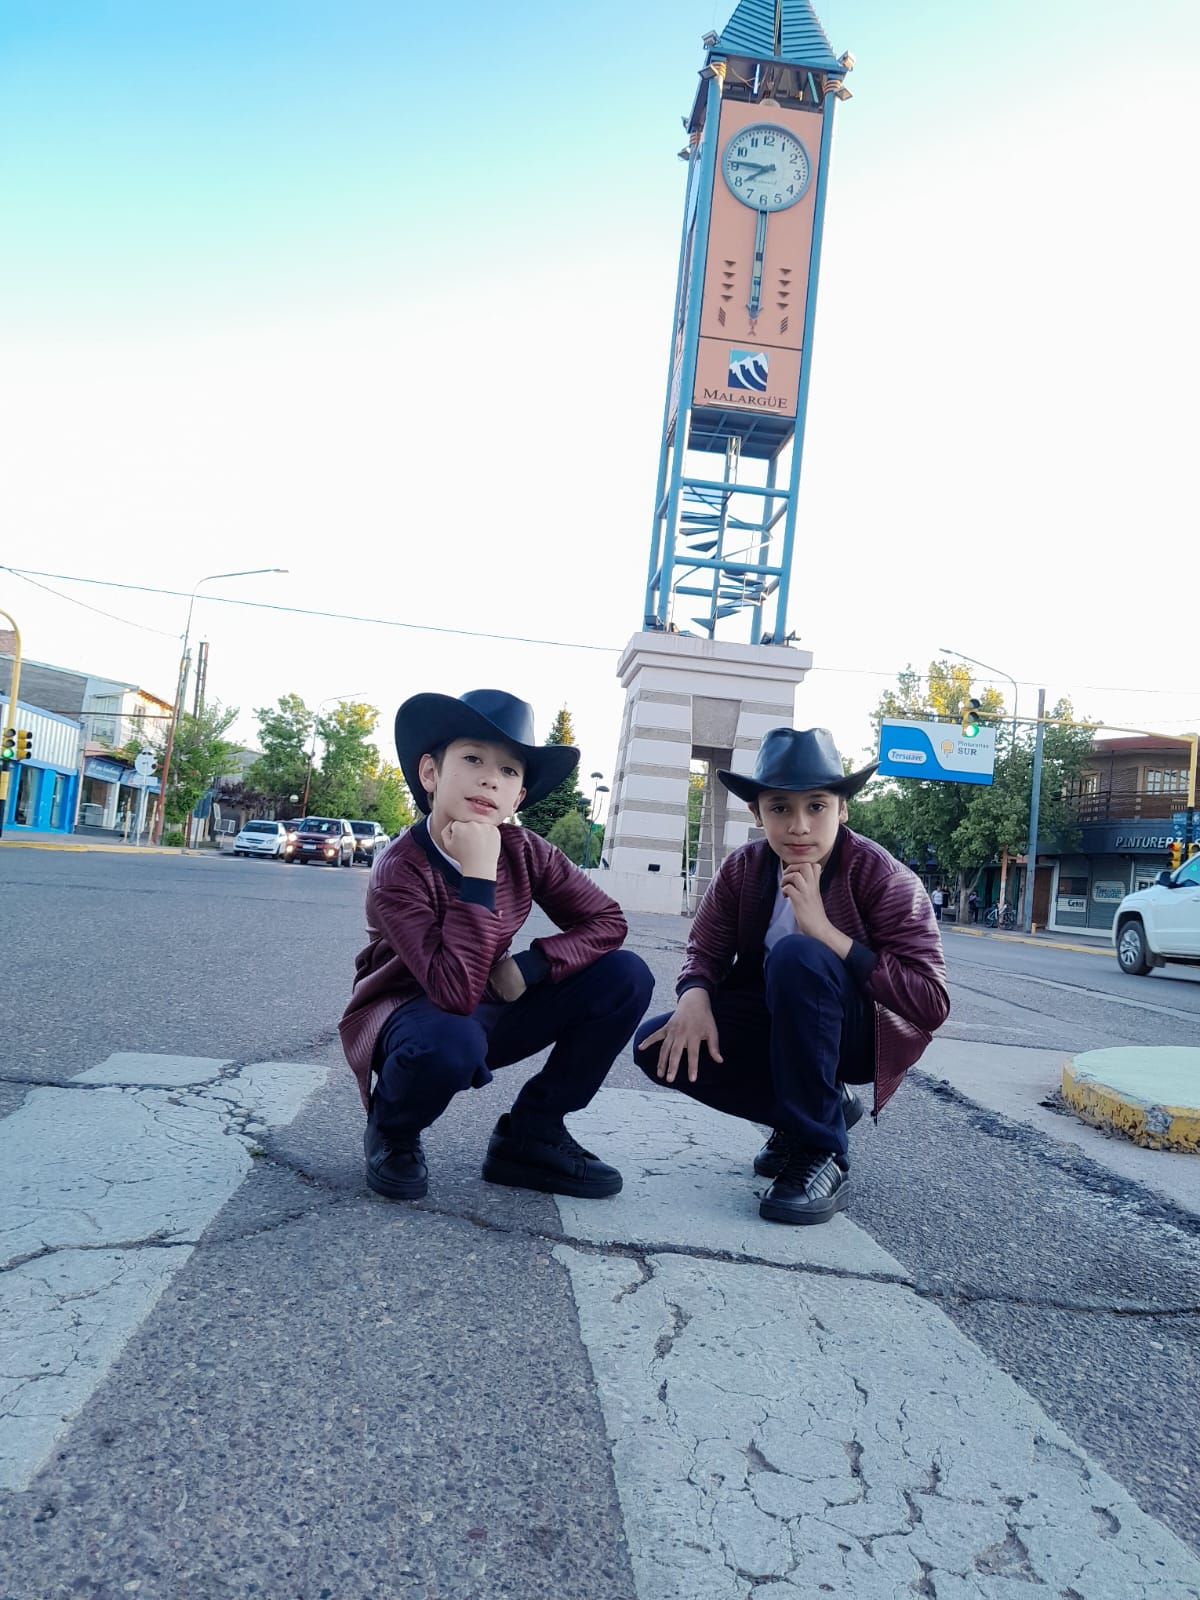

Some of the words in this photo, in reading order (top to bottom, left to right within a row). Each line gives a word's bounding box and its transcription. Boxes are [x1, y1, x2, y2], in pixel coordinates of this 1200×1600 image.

[751, 137, 758, 148] 11
[763, 135, 775, 147] 12
[737, 146, 748, 158] 10
[781, 142, 786, 152] 1
[789, 153, 798, 165] 2
[731, 161, 740, 171] 9
[793, 170, 802, 181] 3
[734, 176, 743, 187] 8
[746, 188, 754, 199] 7
[786, 184, 794, 195] 4
[759, 194, 768, 206] 6
[774, 193, 783, 204] 5
[957, 747, 977, 756] SUR
